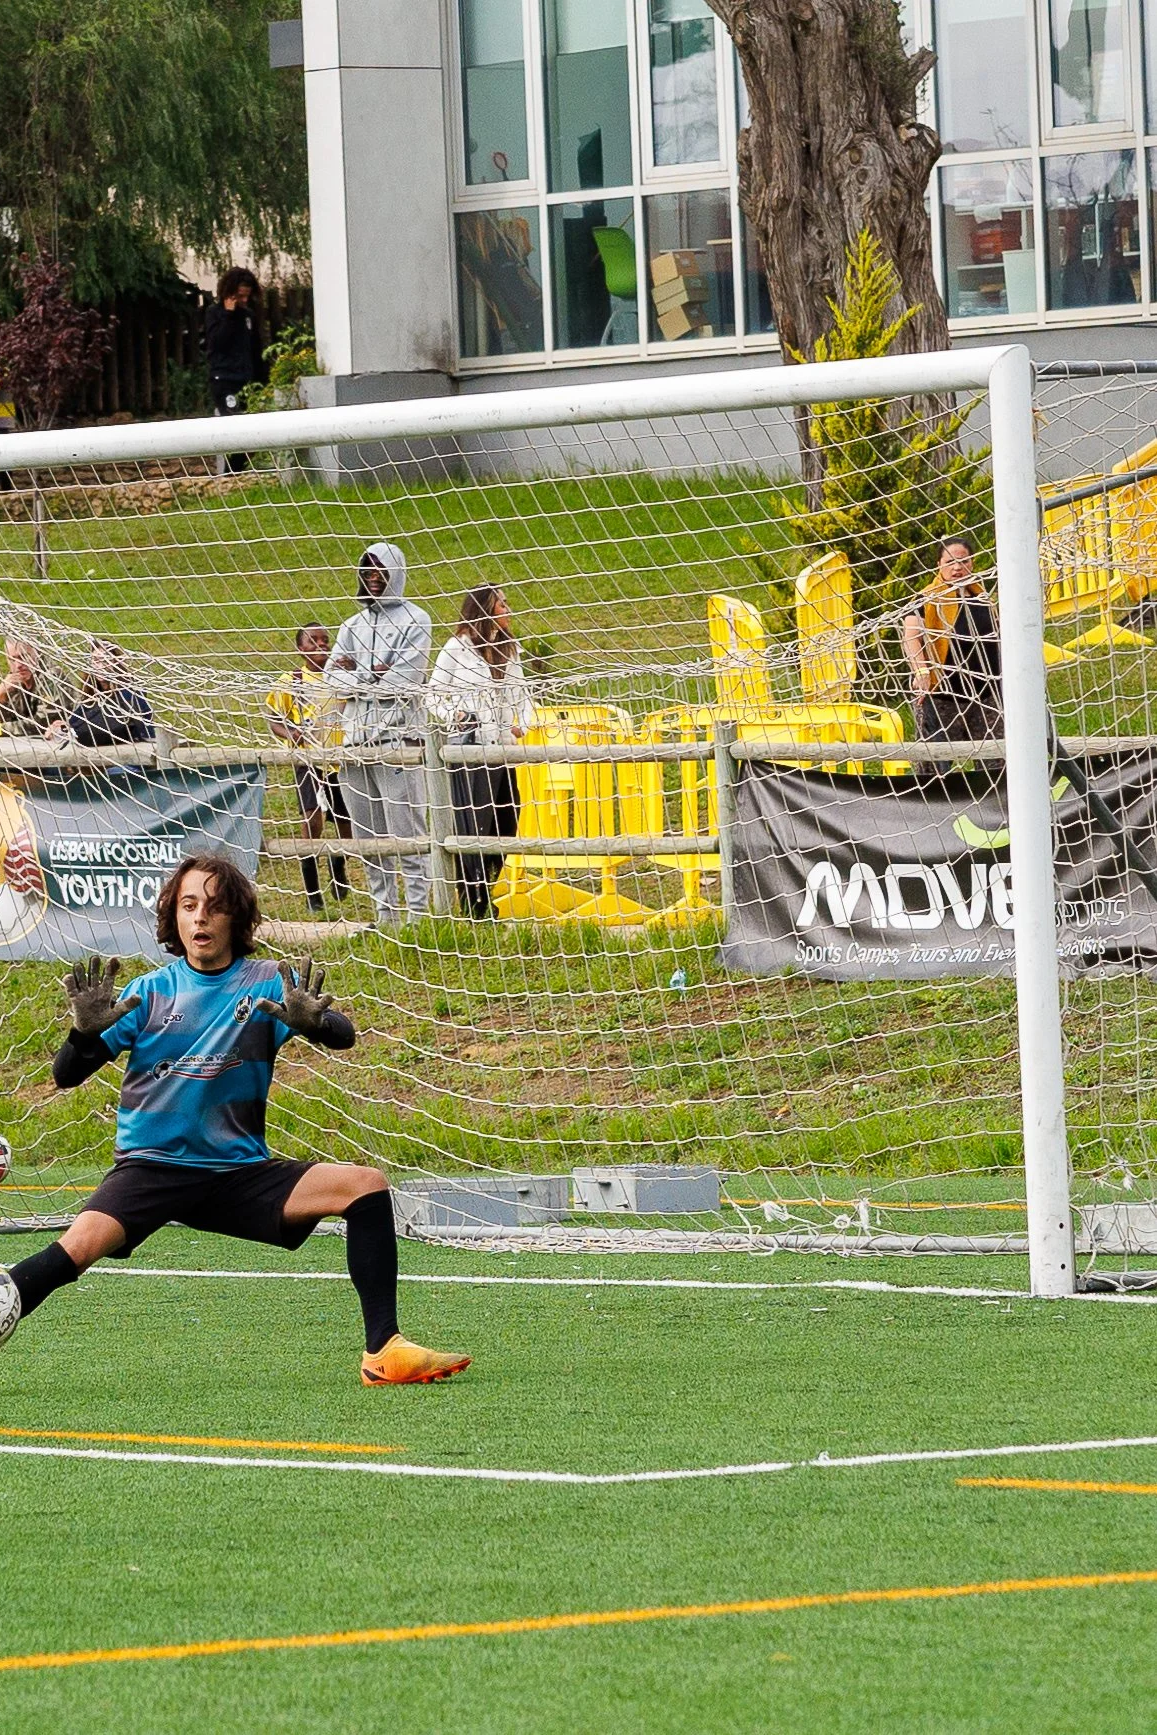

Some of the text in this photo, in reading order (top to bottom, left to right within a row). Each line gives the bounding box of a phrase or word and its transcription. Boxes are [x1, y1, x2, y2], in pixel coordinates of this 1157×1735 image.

[49, 839, 182, 864] LISBON FOOTBALL
[57, 873, 134, 908] YOUTH
[795, 939, 842, 966] Sports
[846, 942, 900, 967] Camps,
[905, 942, 950, 963] Tours
[949, 943, 982, 963] and
